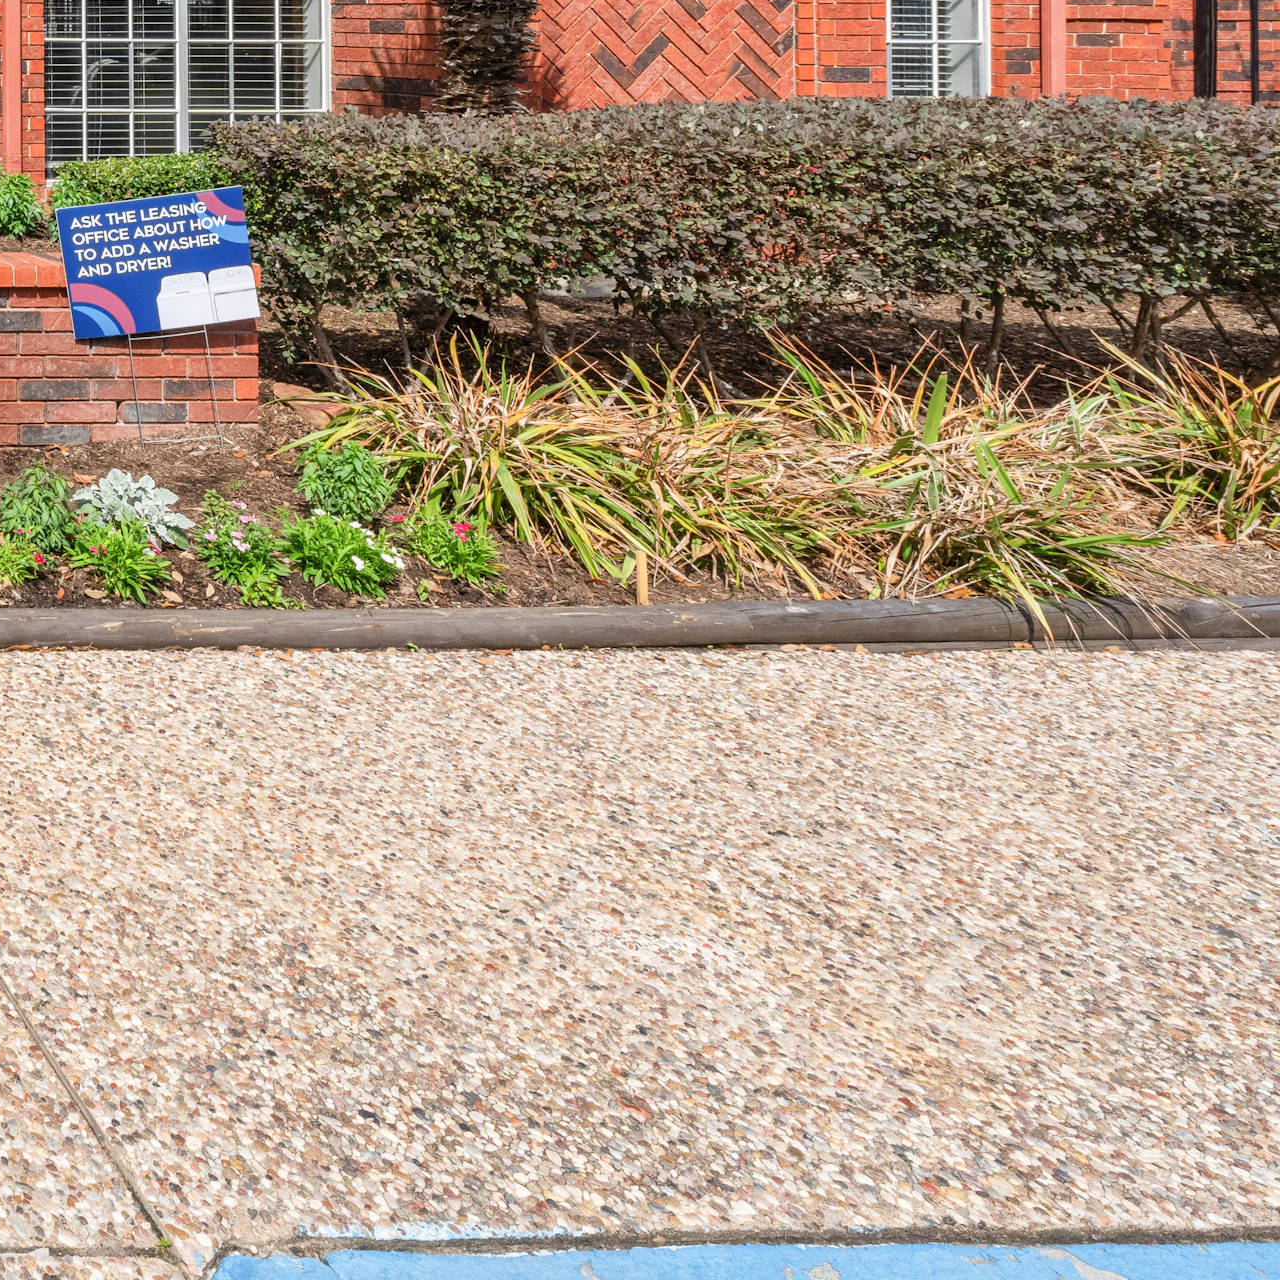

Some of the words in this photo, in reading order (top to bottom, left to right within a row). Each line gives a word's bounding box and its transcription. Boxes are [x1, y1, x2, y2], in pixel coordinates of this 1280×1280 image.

[70, 214, 102, 230] ASK
[105, 210, 137, 226] THE
[140, 201, 208, 222] LEASING
[72, 228, 130, 246] OFFICE
[133, 221, 187, 239] ABOUT
[190, 214, 228, 230] HOW
[74, 248, 97, 262] TO
[101, 244, 135, 260] ADD
[139, 242, 151, 255] A
[153, 233, 221, 253] WASHER
[77, 264, 112, 279] AND
[116, 256, 173, 275] DRYER!
